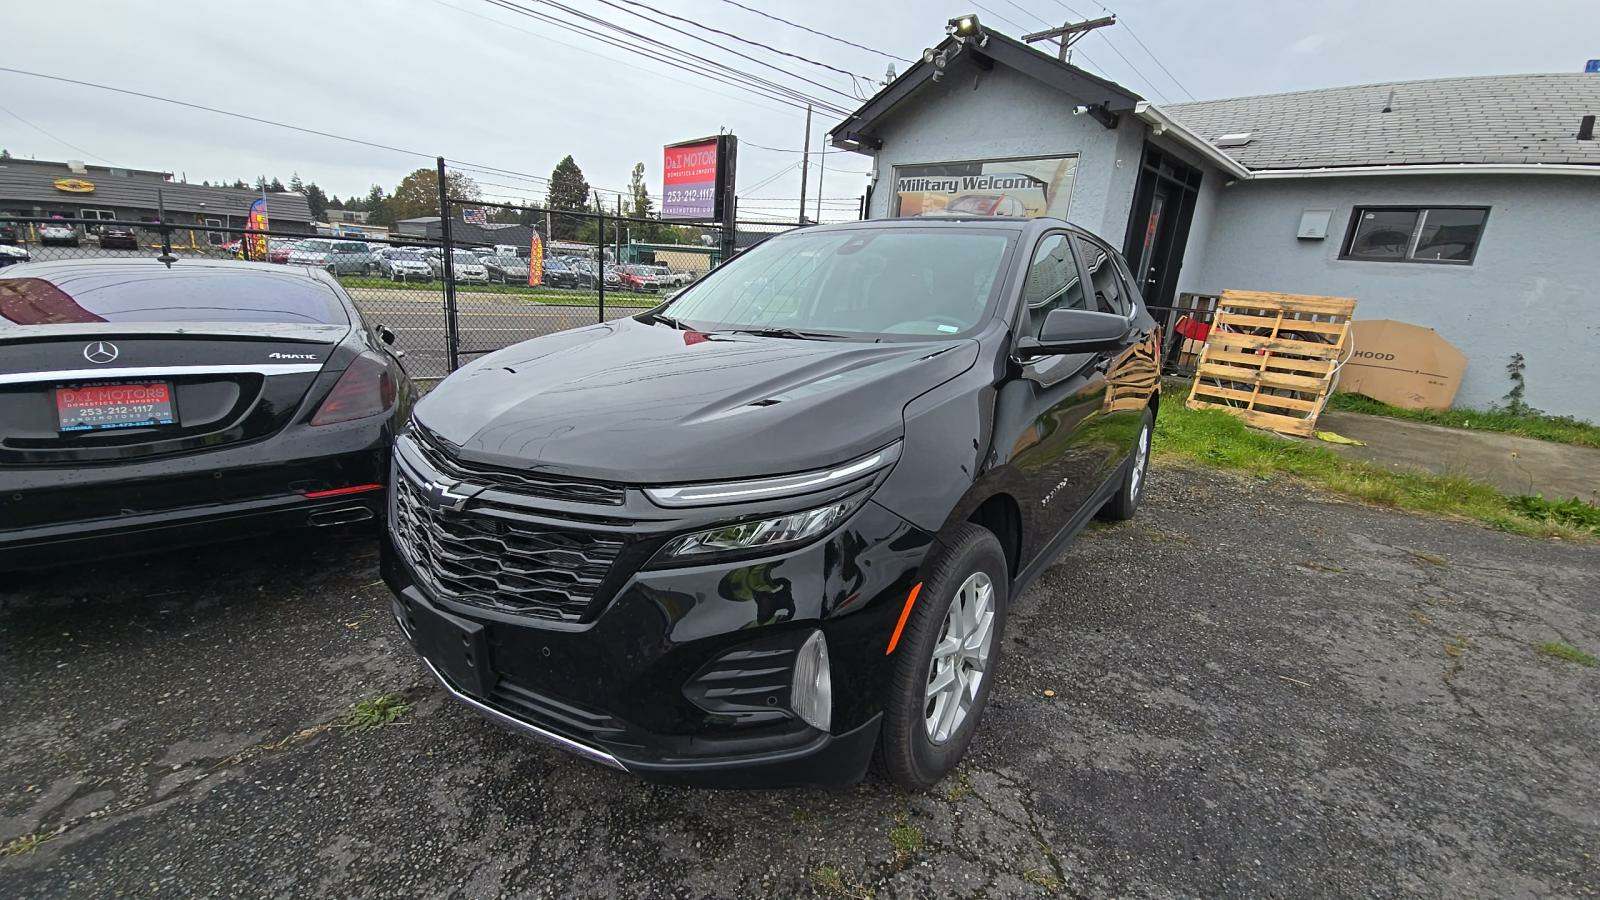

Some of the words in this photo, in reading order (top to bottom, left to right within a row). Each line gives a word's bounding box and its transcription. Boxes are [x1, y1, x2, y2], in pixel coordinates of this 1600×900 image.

[899, 179, 959, 194] Military
[962, 176, 1043, 190] Welcome
[667, 188, 715, 203] 253-212-1117
[268, 352, 317, 360] 4MATIC
[1354, 351, 1395, 361] HOOD
[99, 388, 165, 401] MOTORS
[80, 404, 153, 416] 253-212-1117
